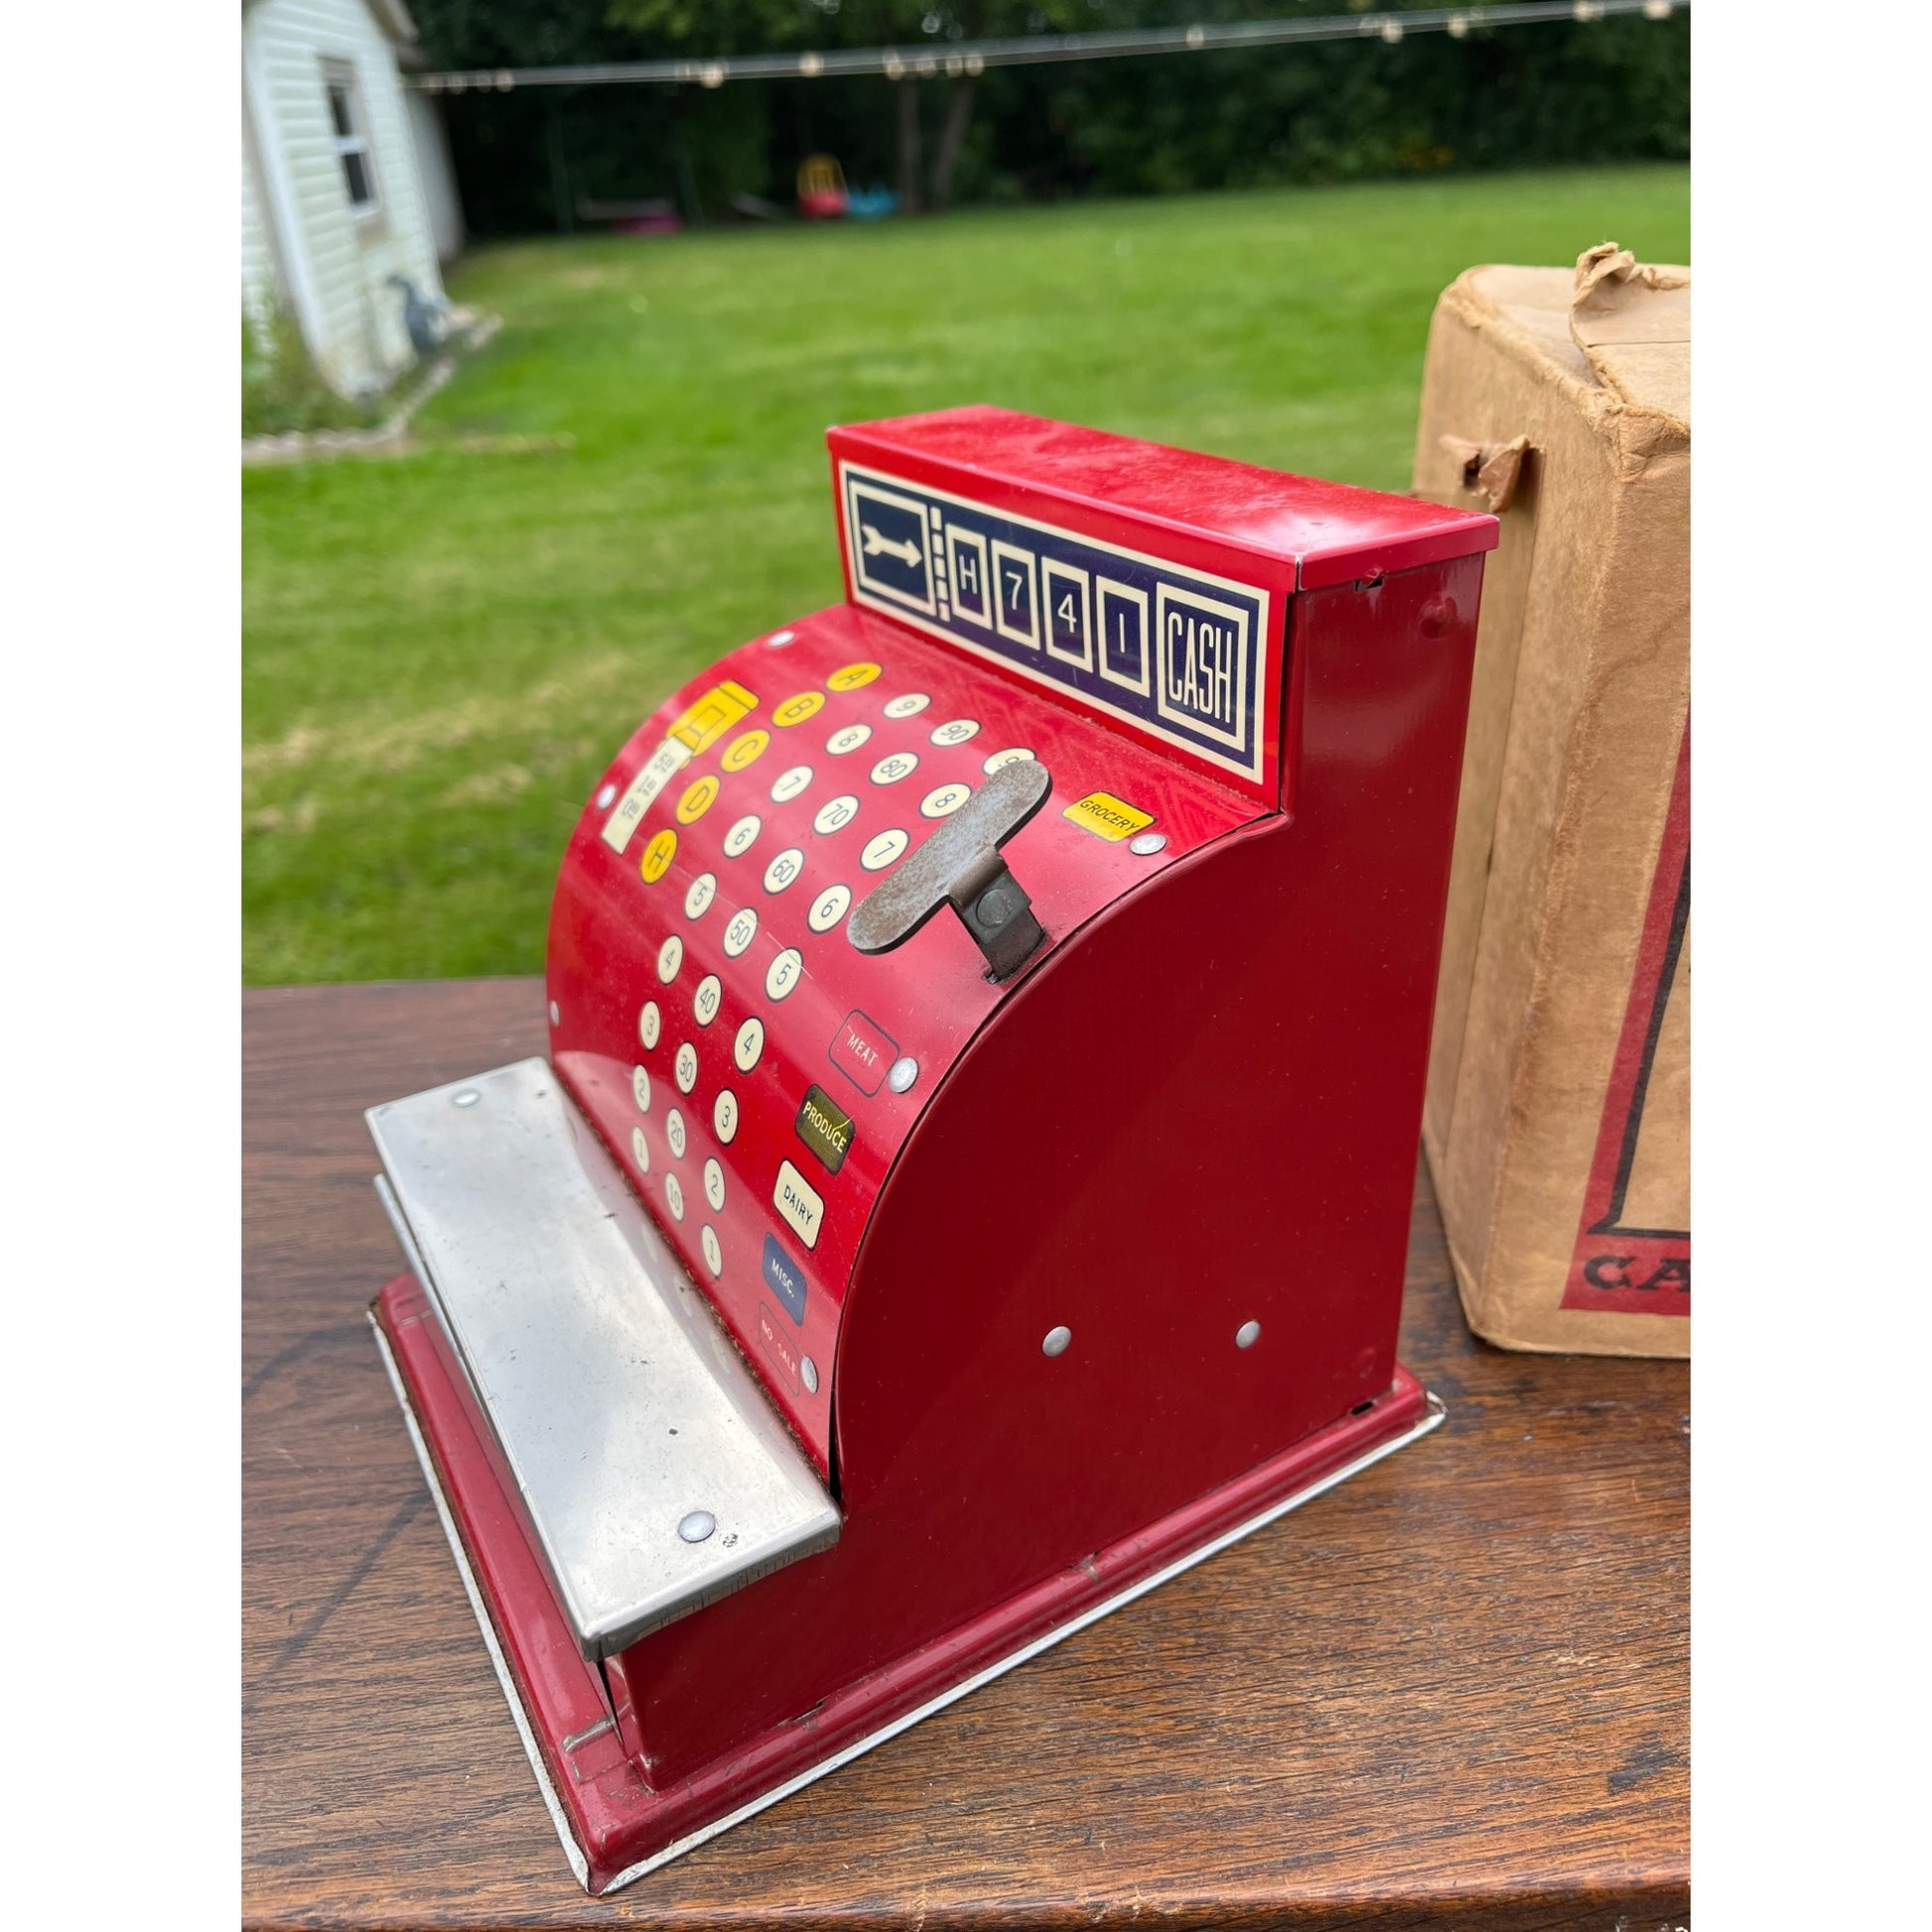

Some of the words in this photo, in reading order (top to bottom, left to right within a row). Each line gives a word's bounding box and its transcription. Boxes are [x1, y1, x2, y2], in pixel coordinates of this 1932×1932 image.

[958, 552, 979, 596] H
[1005, 570, 1023, 612] 7
[1056, 592, 1078, 634] 4
[1167, 611, 1233, 725] CASH
[835, 668, 870, 687] A
[783, 697, 814, 719] B
[895, 699, 917, 713] 9
[838, 732, 860, 748] 8
[939, 724, 970, 742] 90
[731, 739, 759, 763] C
[880, 759, 908, 779] 80
[684, 784, 711, 813] D
[934, 792, 957, 809] 8
[822, 802, 851, 827] 70
[1079, 799, 1141, 832] GROCERY
[734, 827, 753, 847] 6
[872, 840, 897, 859] 7
[646, 838, 673, 875] H
[771, 859, 796, 885] 60
[693, 886, 709, 907] 5
[820, 897, 840, 919] 6
[729, 918, 752, 947] 50
[663, 948, 677, 970] 4
[774, 963, 793, 986] 5
[699, 987, 717, 1016] 40
[646, 1014, 656, 1037] 3
[743, 1033, 757, 1056] 4
[847, 1033, 879, 1067] MEAT
[678, 1053, 694, 1083] 30
[721, 1104, 733, 1129] 3
[802, 1100, 848, 1154] PRODUCE
[670, 1119, 684, 1150] 20
[669, 1181, 681, 1212] 10
[710, 1173, 720, 1198] 2
[782, 1183, 814, 1226] DAIRY
[770, 1258, 795, 1299] MISC.
[1583, 1254, 1690, 1292] CA
[760, 1318, 773, 1341] NO
[777, 1342, 797, 1376] SALE
